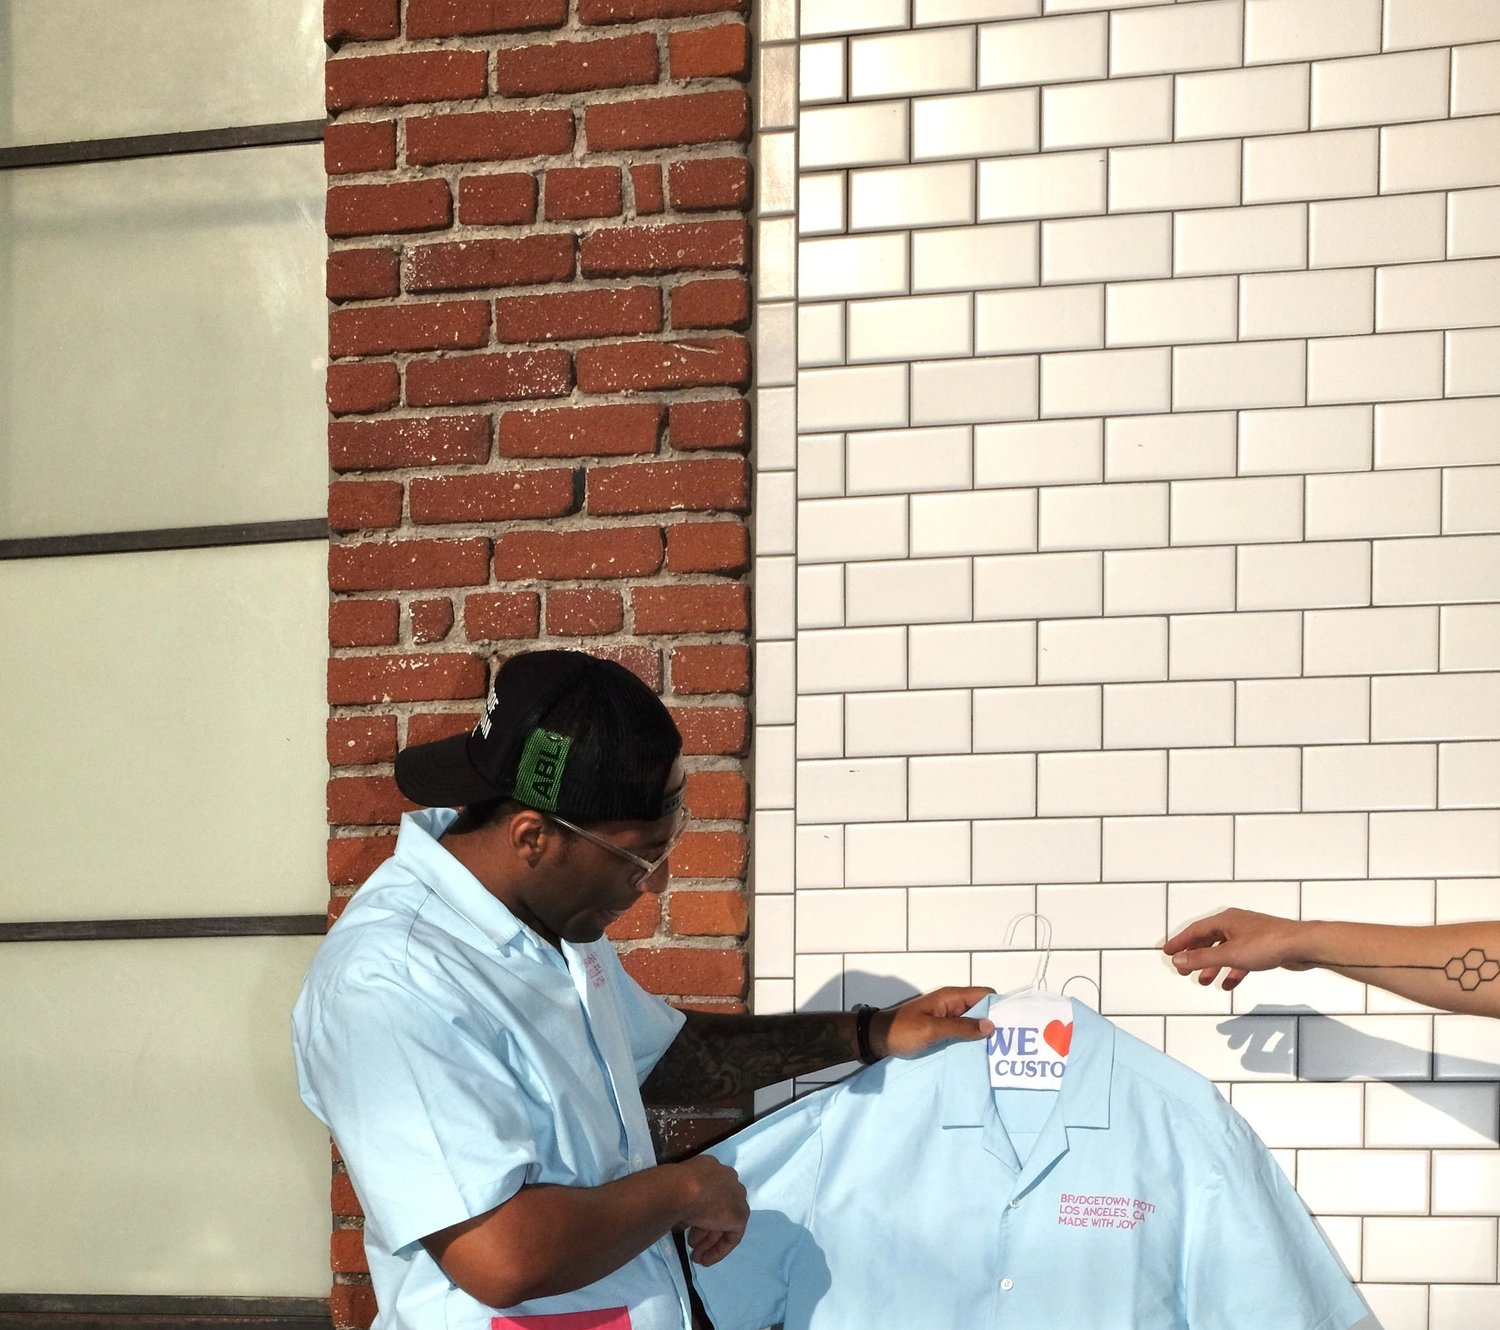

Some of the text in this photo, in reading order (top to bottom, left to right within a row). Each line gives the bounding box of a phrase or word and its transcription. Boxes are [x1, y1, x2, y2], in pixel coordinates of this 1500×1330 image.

[987, 1027, 1039, 1056] WE
[995, 1060, 1066, 1078] CUSTO
[1060, 1193, 1156, 1214] BRIDGETOWN ROTI
[1059, 1205, 1080, 1216] LOS
[1132, 1210, 1146, 1222] CA
[1058, 1216, 1137, 1230] MADE WITH JOY
